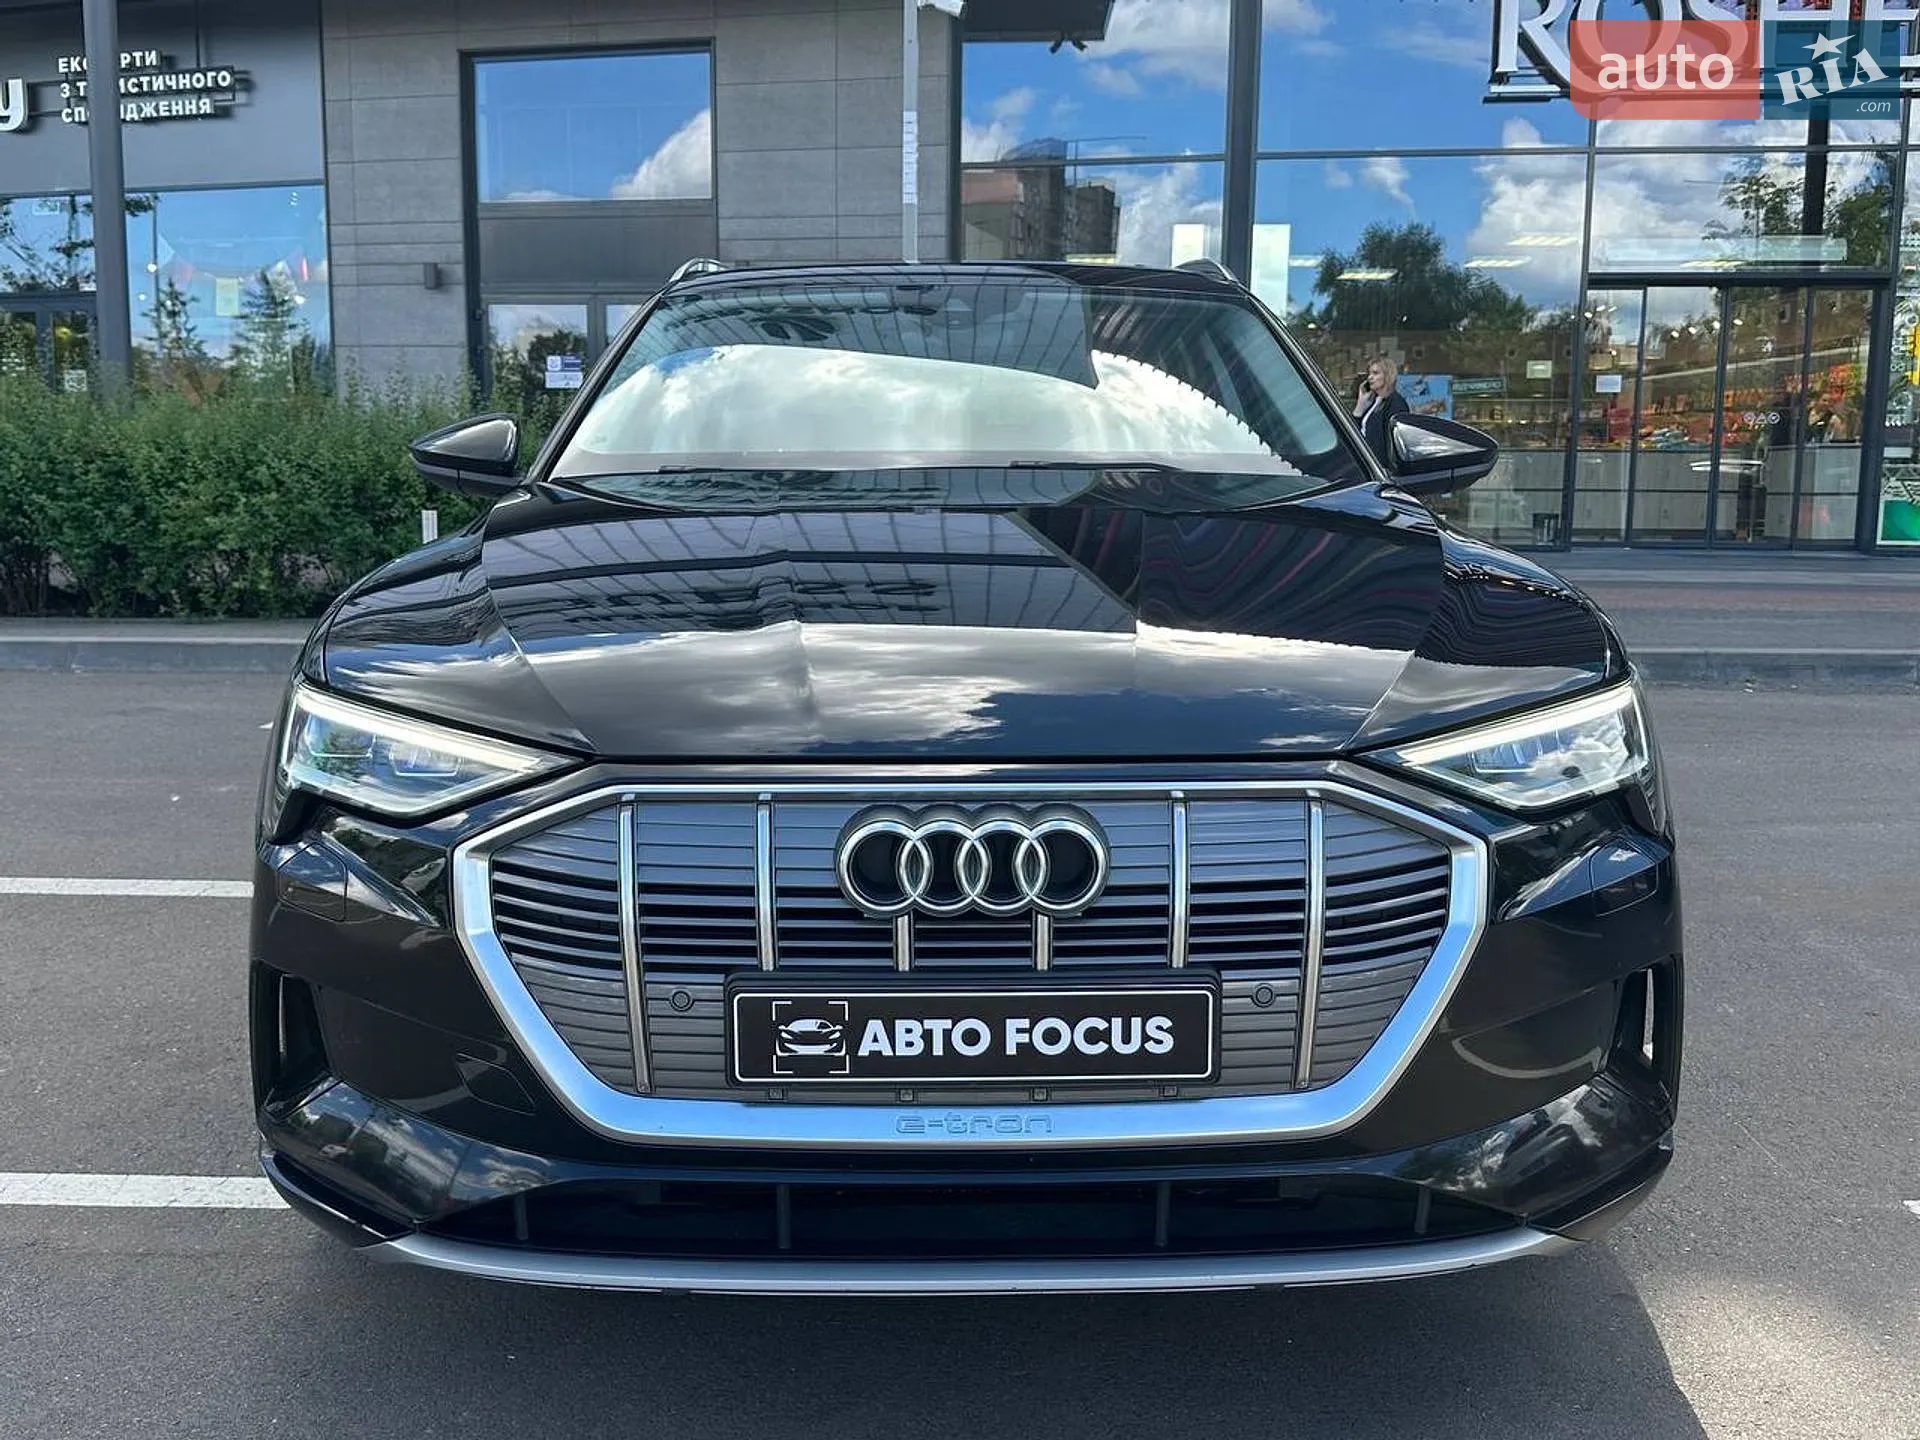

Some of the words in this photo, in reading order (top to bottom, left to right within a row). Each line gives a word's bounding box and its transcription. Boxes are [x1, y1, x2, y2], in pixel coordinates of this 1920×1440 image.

[58, 50, 157, 73] ЕКРТИ
[76, 70, 232, 97] ТСТИЧНОГО
[61, 98, 213, 124] СПДЖЕННЯ
[1005, 1016, 1176, 1056] FOCUS
[895, 1111, 1053, 1134] e-tron
